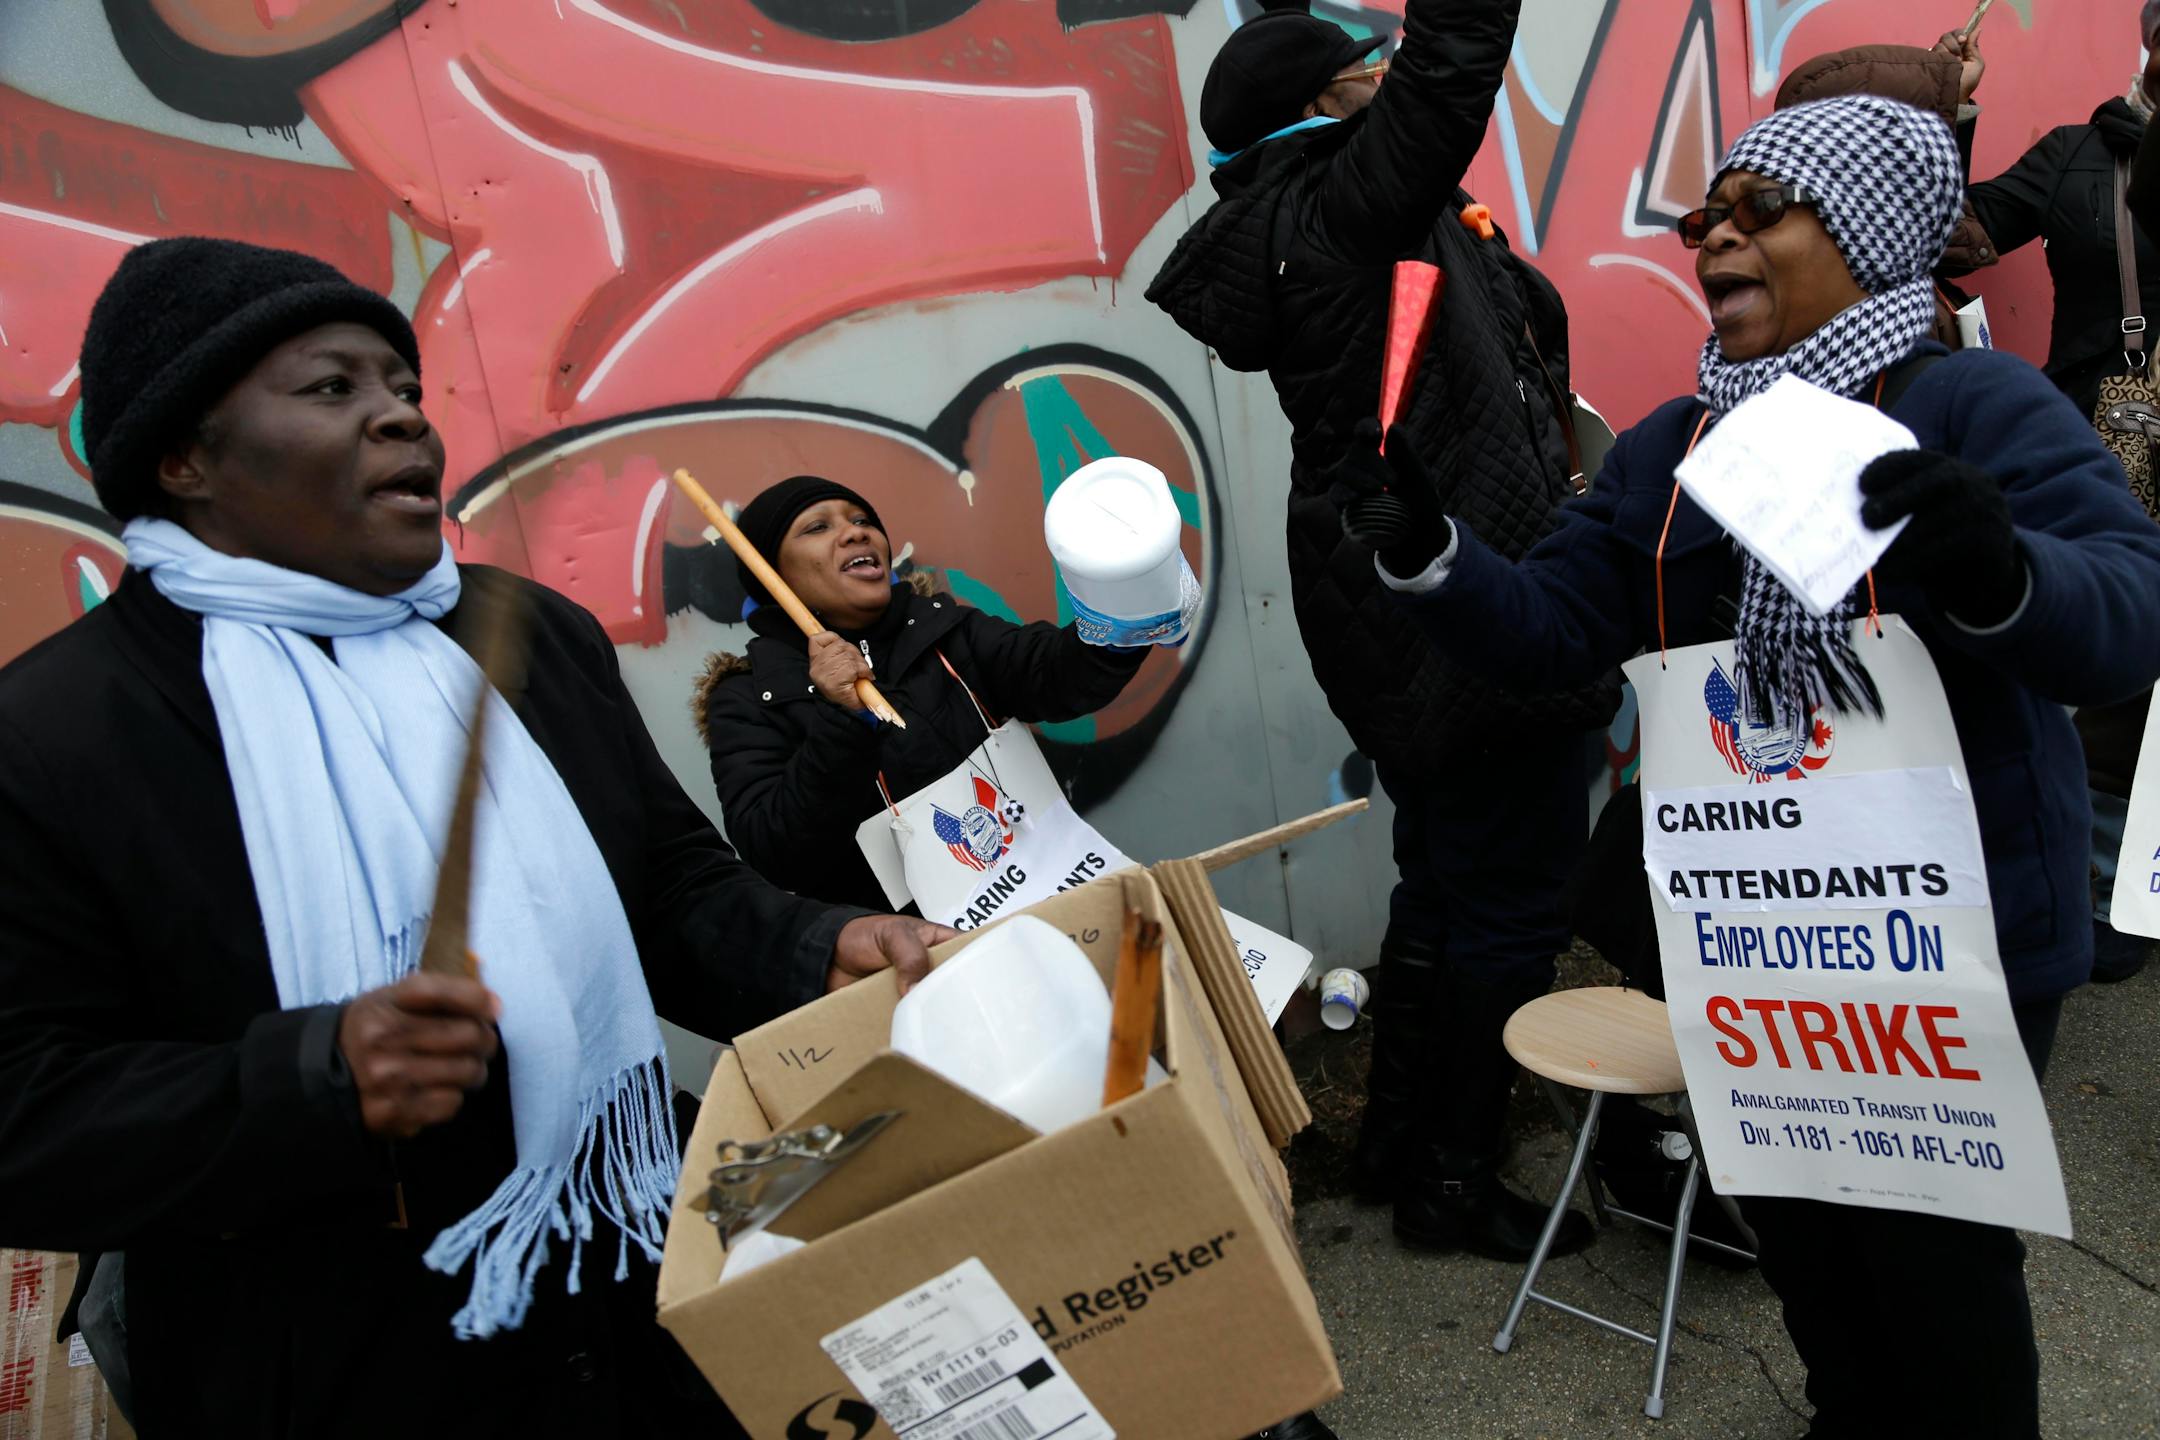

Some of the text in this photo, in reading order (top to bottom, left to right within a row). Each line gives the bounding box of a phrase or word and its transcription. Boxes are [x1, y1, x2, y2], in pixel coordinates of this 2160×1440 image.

[1735, 738, 1767, 772] TRANSIT
[1787, 735, 1807, 766] UNION
[1657, 797, 1802, 833] CARING
[953, 864, 1027, 932] CARING
[1669, 863, 1949, 899] ATTENDANTS
[1706, 995, 1982, 1081] STRIKE
[1731, 1089, 1997, 1129] AMALGAMATED TRANSIT UNION
[1783, 1123, 1832, 1152] 1181
[1851, 1129, 1904, 1159] 1061
[1912, 1134, 2005, 1171] AFL-CIO
[921, 1368, 942, 1388] NY
